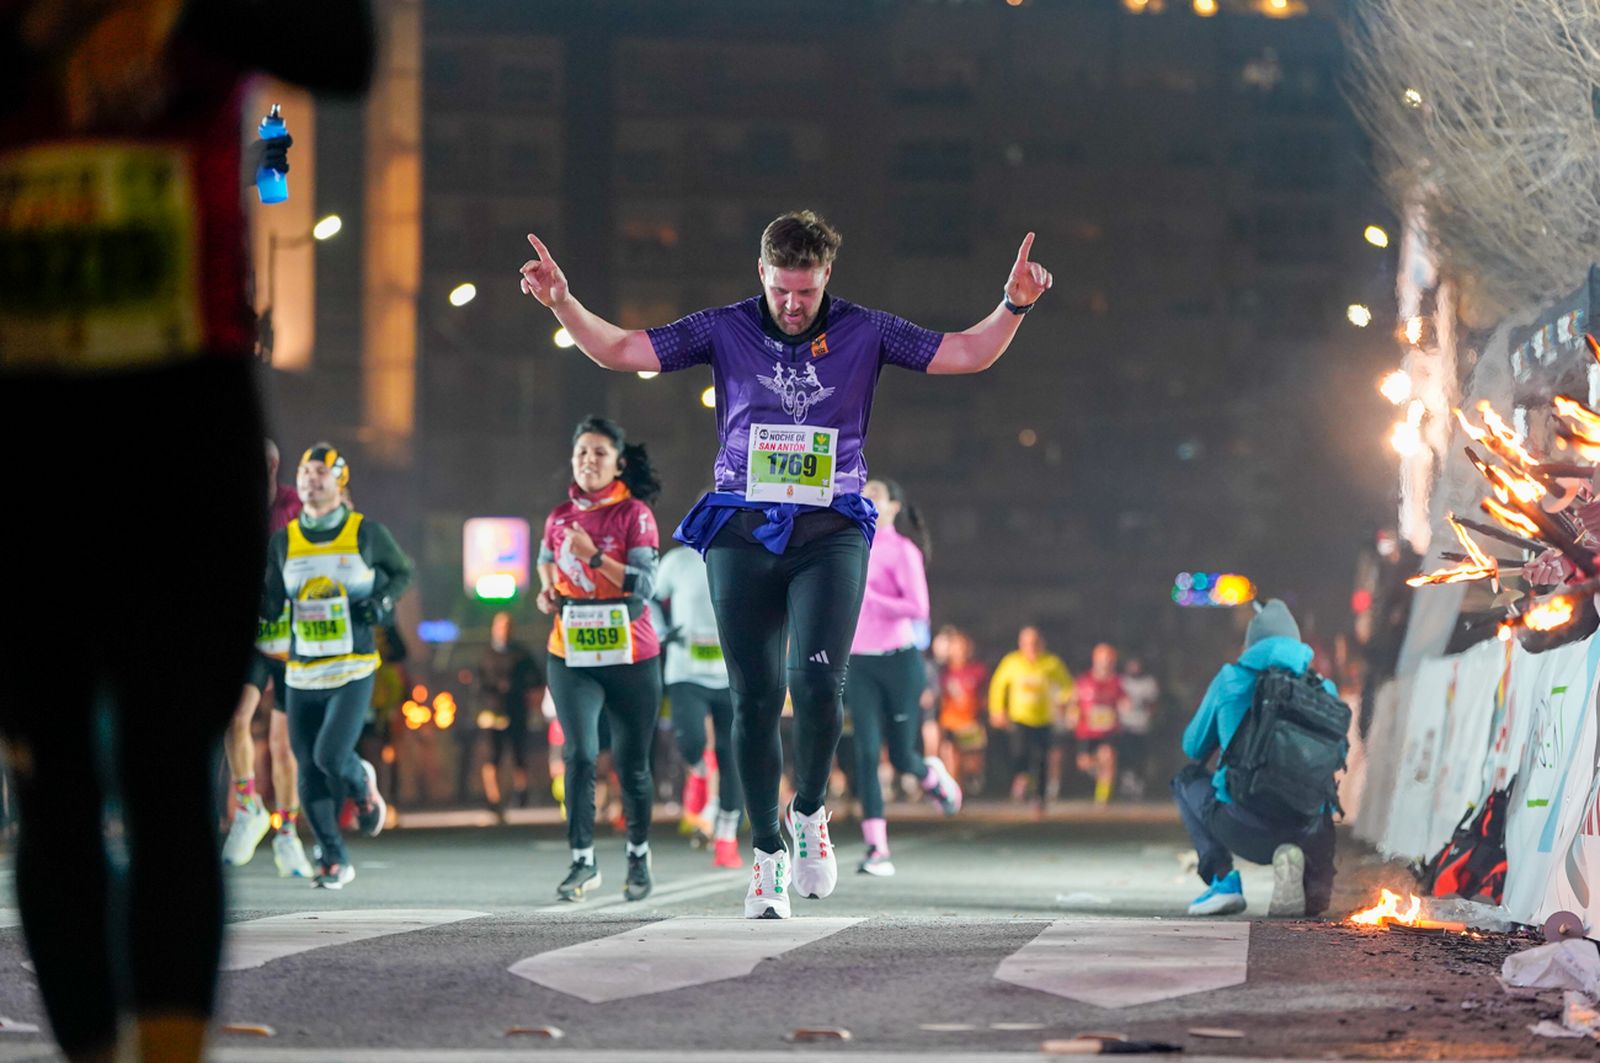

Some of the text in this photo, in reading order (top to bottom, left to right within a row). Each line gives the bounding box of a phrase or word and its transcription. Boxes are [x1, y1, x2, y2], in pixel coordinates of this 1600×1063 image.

[769, 433, 795, 442] NOCHE
[795, 434, 806, 442] DE
[759, 442, 776, 451] SAN
[777, 442, 806, 452] ANTÓN
[768, 452, 817, 477] 1769
[576, 628, 619, 646] 4369
